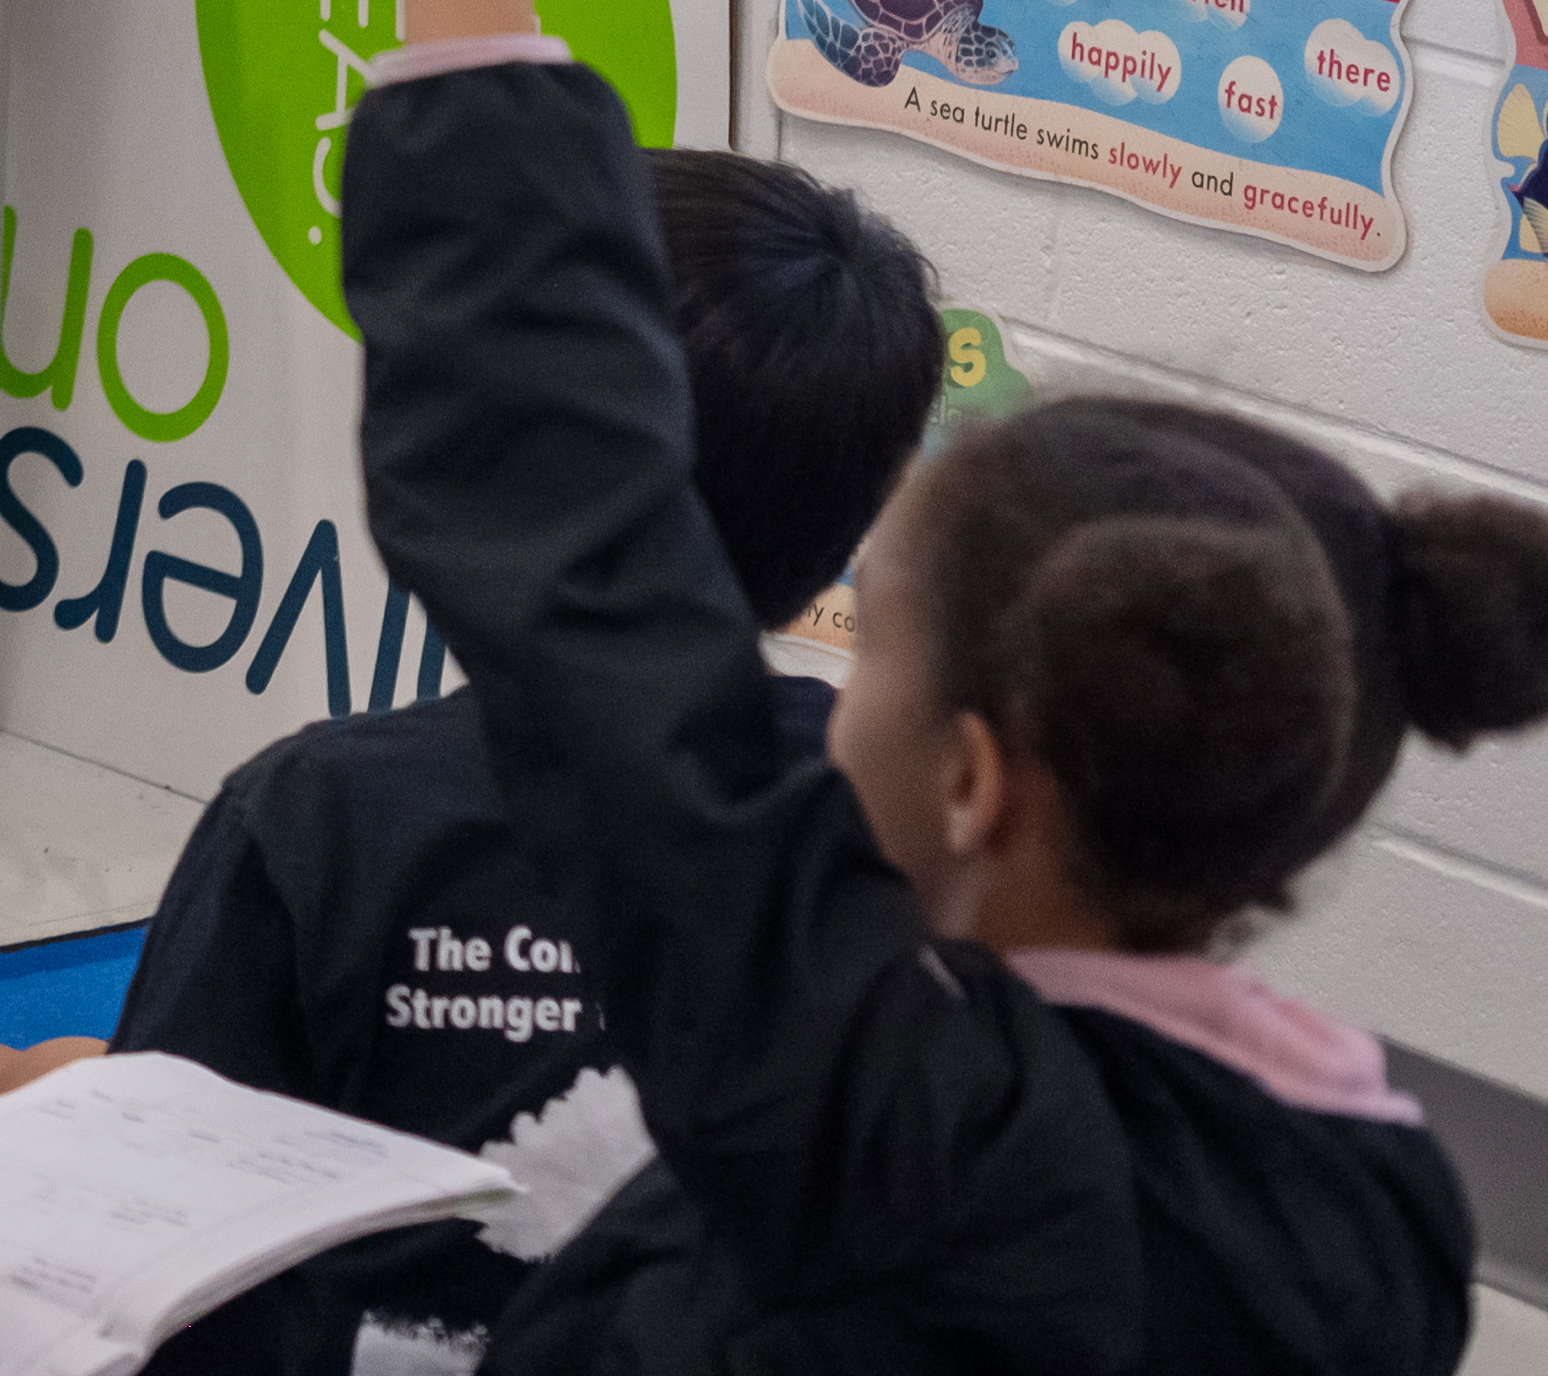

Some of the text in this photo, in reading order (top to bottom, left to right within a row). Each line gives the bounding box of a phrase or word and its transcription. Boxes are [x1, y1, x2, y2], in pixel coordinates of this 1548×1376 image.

[1069, 32, 1175, 93] happily
[1315, 47, 1392, 94] there
[1223, 79, 1281, 122] fast
[904, 84, 1383, 242] A sea turtle swims slowly and gracefully.
[407, 926, 493, 973] The
[385, 984, 583, 1043] Stronger
